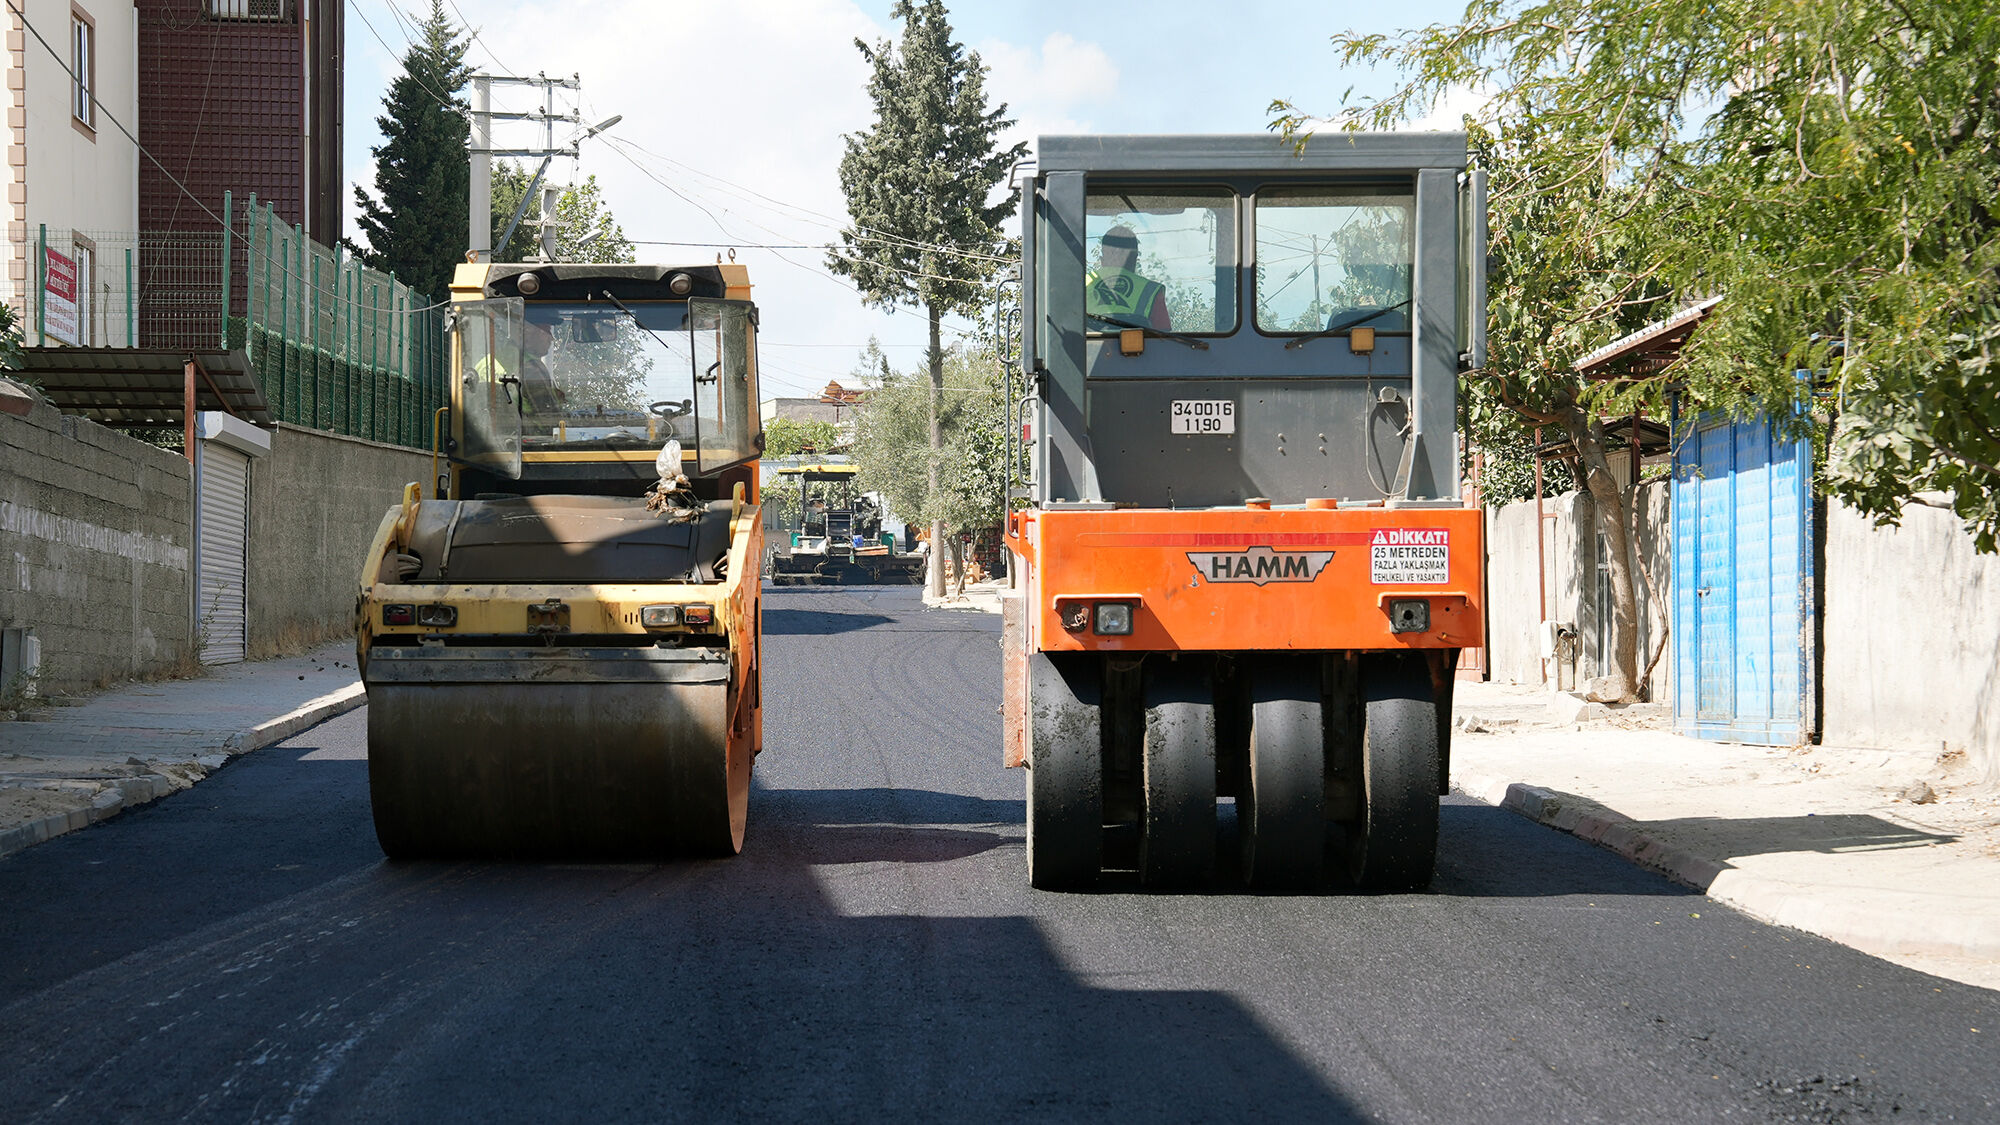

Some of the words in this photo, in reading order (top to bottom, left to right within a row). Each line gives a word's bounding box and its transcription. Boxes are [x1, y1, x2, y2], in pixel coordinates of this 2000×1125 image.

[1173, 402, 1232, 416] 340016
[1185, 418, 1221, 431] 1190
[1389, 528, 1448, 544] DİKKAT!
[1374, 547, 1387, 558] 25
[1389, 547, 1446, 558] METREDEN
[1212, 556, 1310, 578] HAMM
[1374, 560, 1398, 570] FAZLA
[1399, 560, 1446, 572] YAKLAŞMAK
[1374, 571, 1405, 582] TEHLİKELİ
[1406, 573, 1415, 582] VE
[1416, 573, 1446, 582] YASAKTIR
